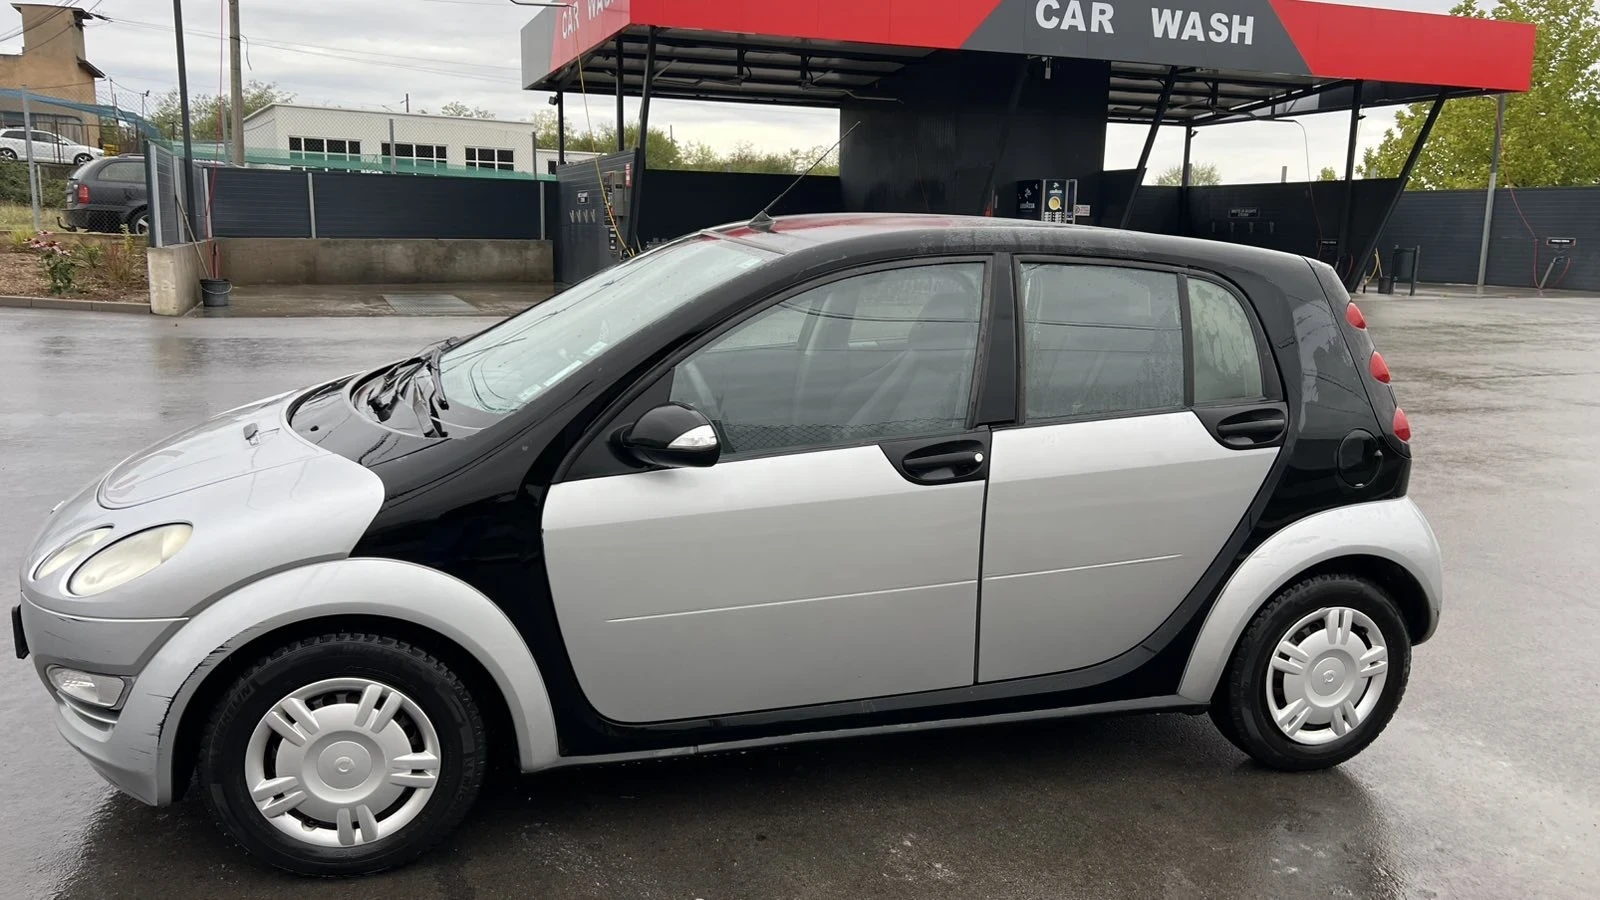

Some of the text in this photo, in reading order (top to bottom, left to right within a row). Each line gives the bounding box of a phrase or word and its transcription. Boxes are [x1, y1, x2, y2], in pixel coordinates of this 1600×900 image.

[562, 0, 614, 39] CAR WA
[1035, 0, 1254, 45] CAR WASH
